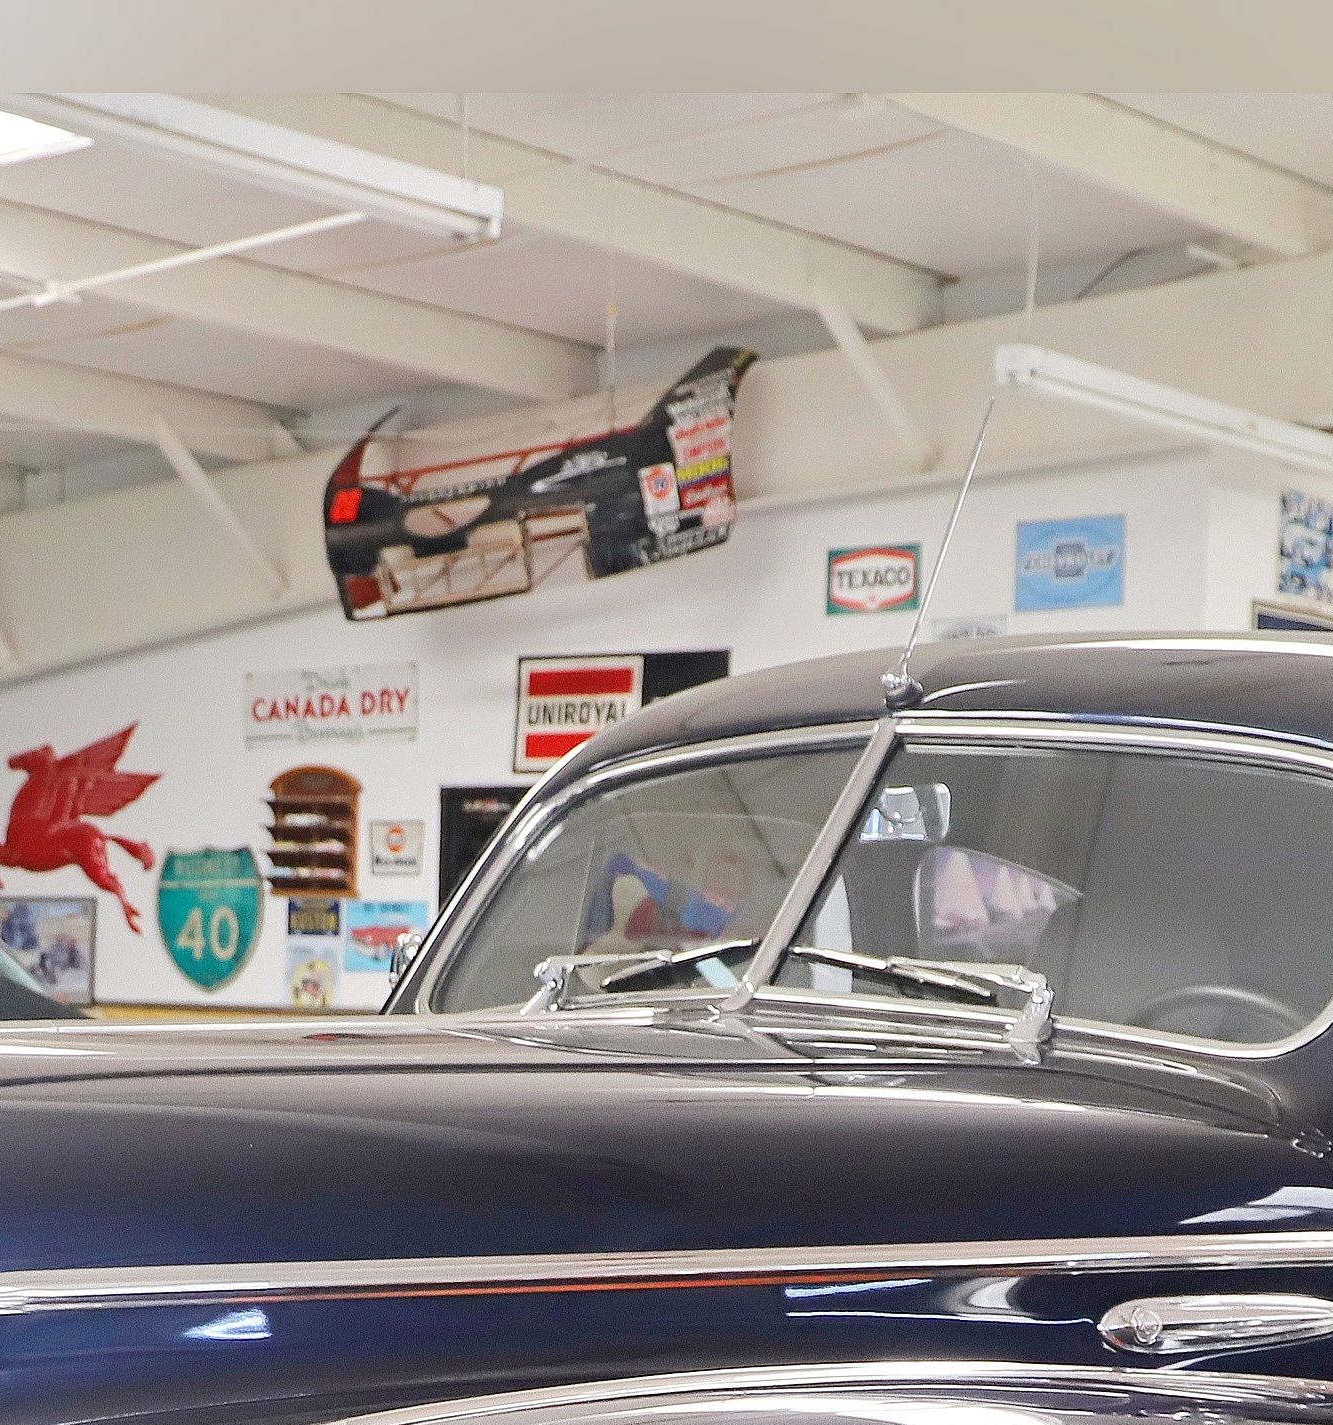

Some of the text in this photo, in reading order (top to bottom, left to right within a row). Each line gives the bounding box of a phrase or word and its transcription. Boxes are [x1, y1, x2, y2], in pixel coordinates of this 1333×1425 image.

[836, 565, 910, 590] TEXACO
[251, 686, 410, 724] CANADA DRY
[176, 904, 240, 962] 40
